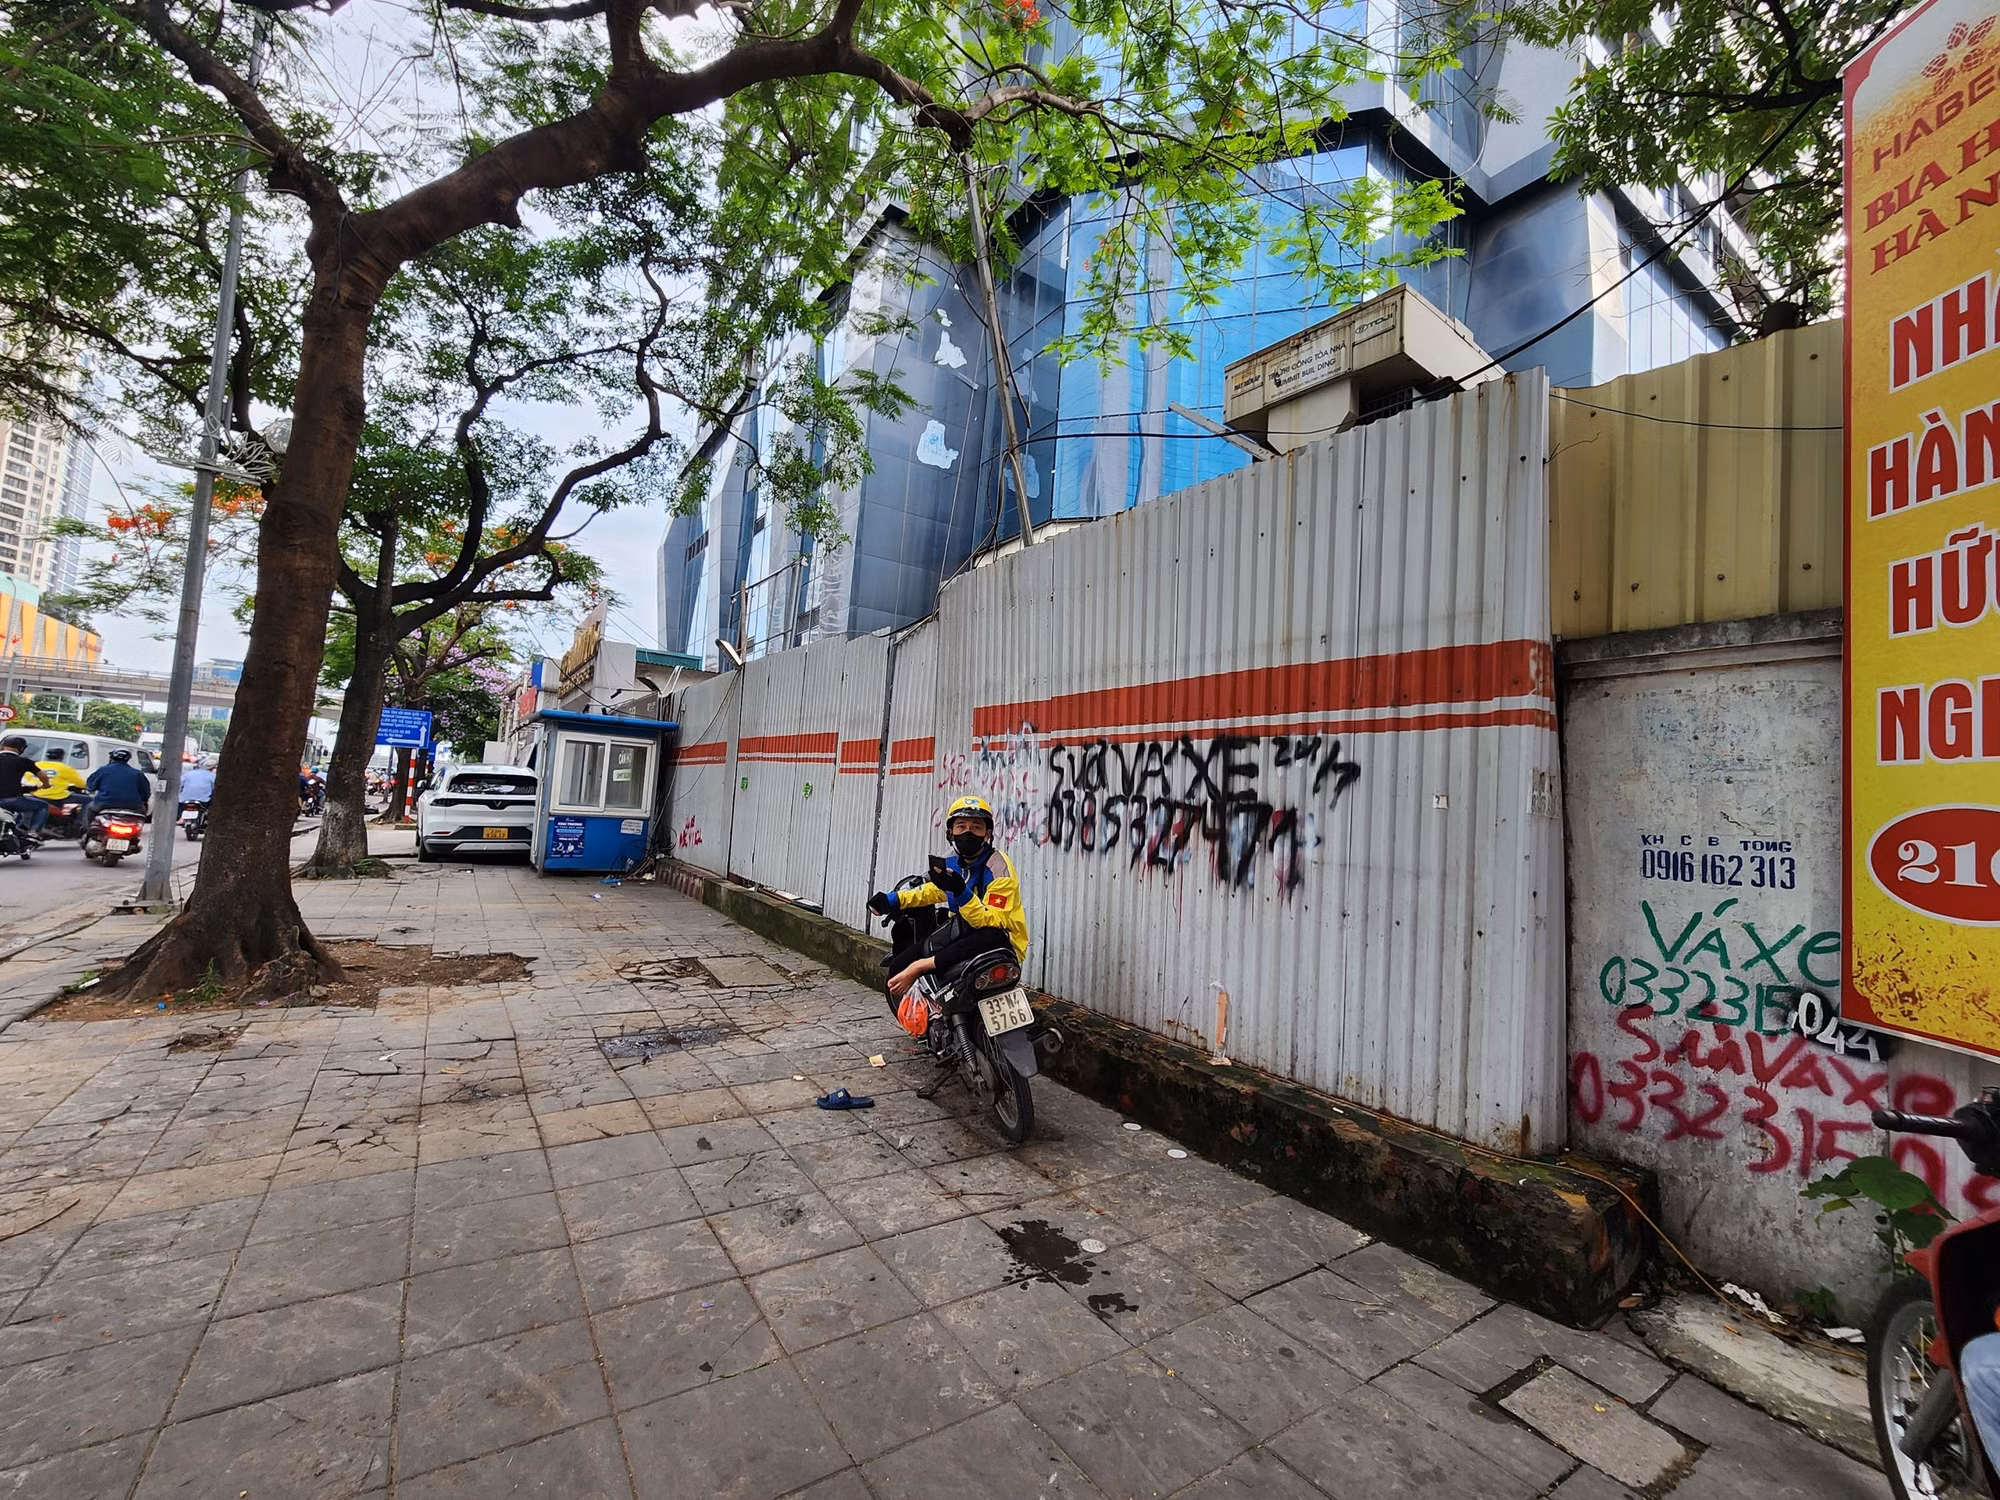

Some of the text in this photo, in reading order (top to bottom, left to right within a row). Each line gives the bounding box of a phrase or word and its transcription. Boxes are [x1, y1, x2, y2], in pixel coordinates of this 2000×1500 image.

[1873, 64, 2000, 173] HABE
[1863, 160, 1952, 234] BIA
[1870, 208, 1950, 276] HÀ
[1291, 356, 1313, 371] CÔNG
[1314, 350, 1329, 361] TÒA
[1889, 268, 2000, 394] NH
[1888, 522, 2000, 639] HỮ
[1641, 834, 1664, 846] KH
[1680, 835, 1692, 846] C
[1642, 849, 1796, 890] 0916 162 313
[1897, 837, 2000, 888] 21
[991, 1009, 1027, 1031] 5766
